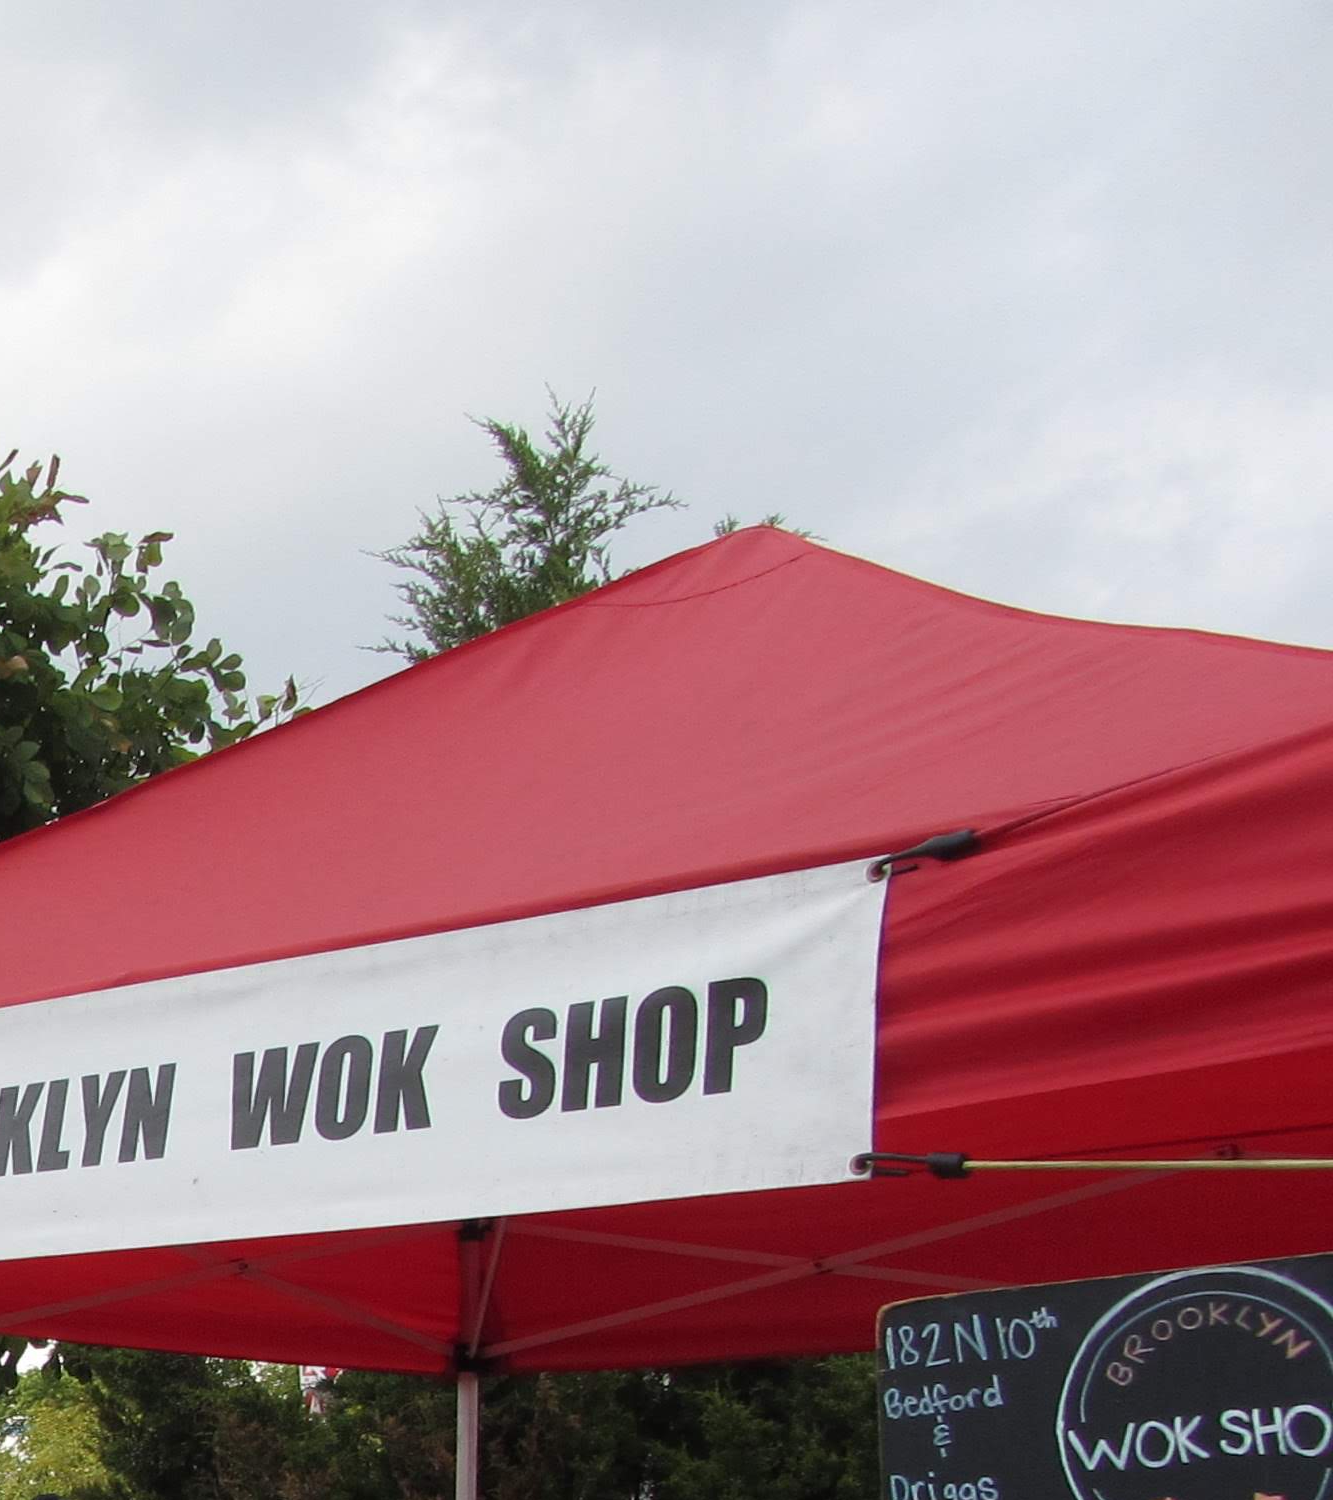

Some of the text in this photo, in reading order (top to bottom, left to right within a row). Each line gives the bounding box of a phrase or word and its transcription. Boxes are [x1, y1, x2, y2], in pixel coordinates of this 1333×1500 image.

[231, 1025, 441, 1151] WOK
[498, 976, 770, 1119] SHOP
[1106, 1302, 1312, 1387] BROOKLYN
[883, 1375, 1004, 1421] Bedford
[1068, 1404, 1333, 1471] WOK SHO
